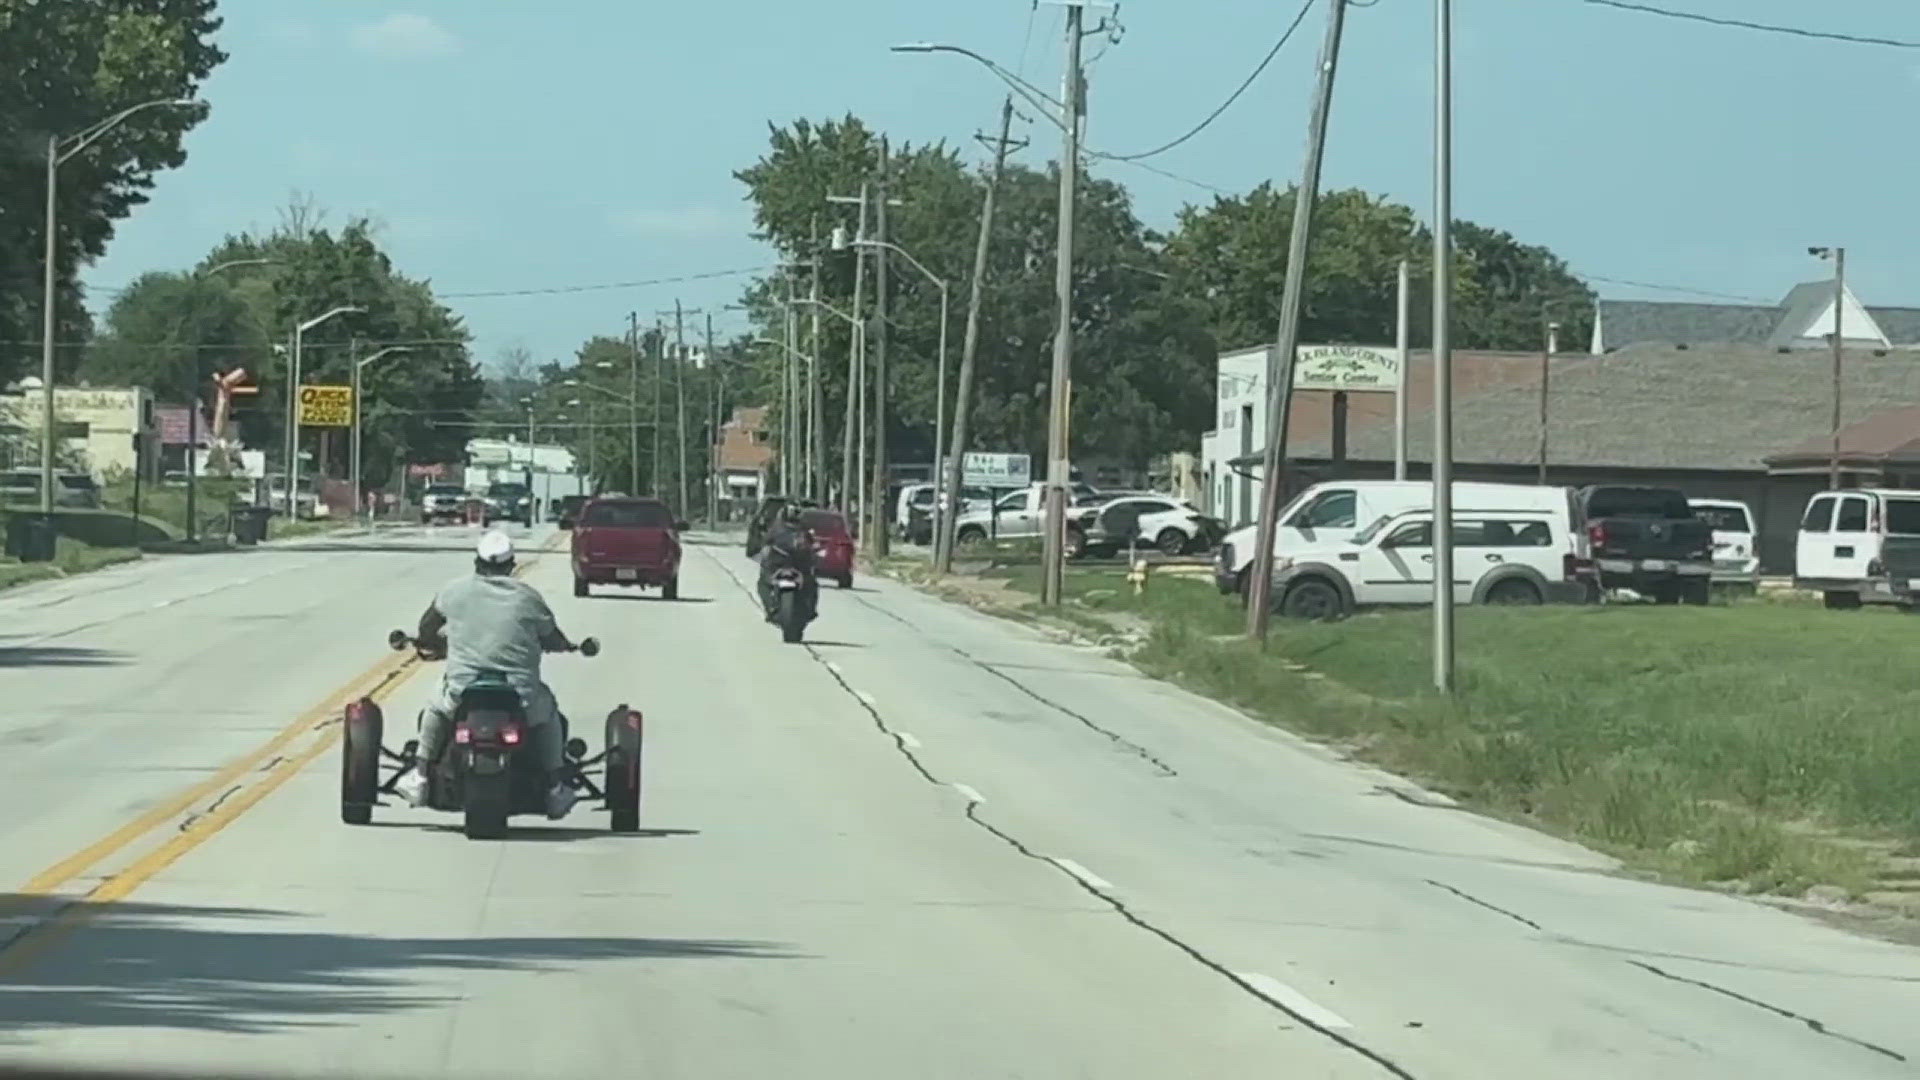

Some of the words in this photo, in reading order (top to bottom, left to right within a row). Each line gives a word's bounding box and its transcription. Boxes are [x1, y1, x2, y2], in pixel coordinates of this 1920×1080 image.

[1314, 346, 1355, 358] ISLAND
[1303, 371, 1337, 383] Senior
[1342, 371, 1380, 383] Center
